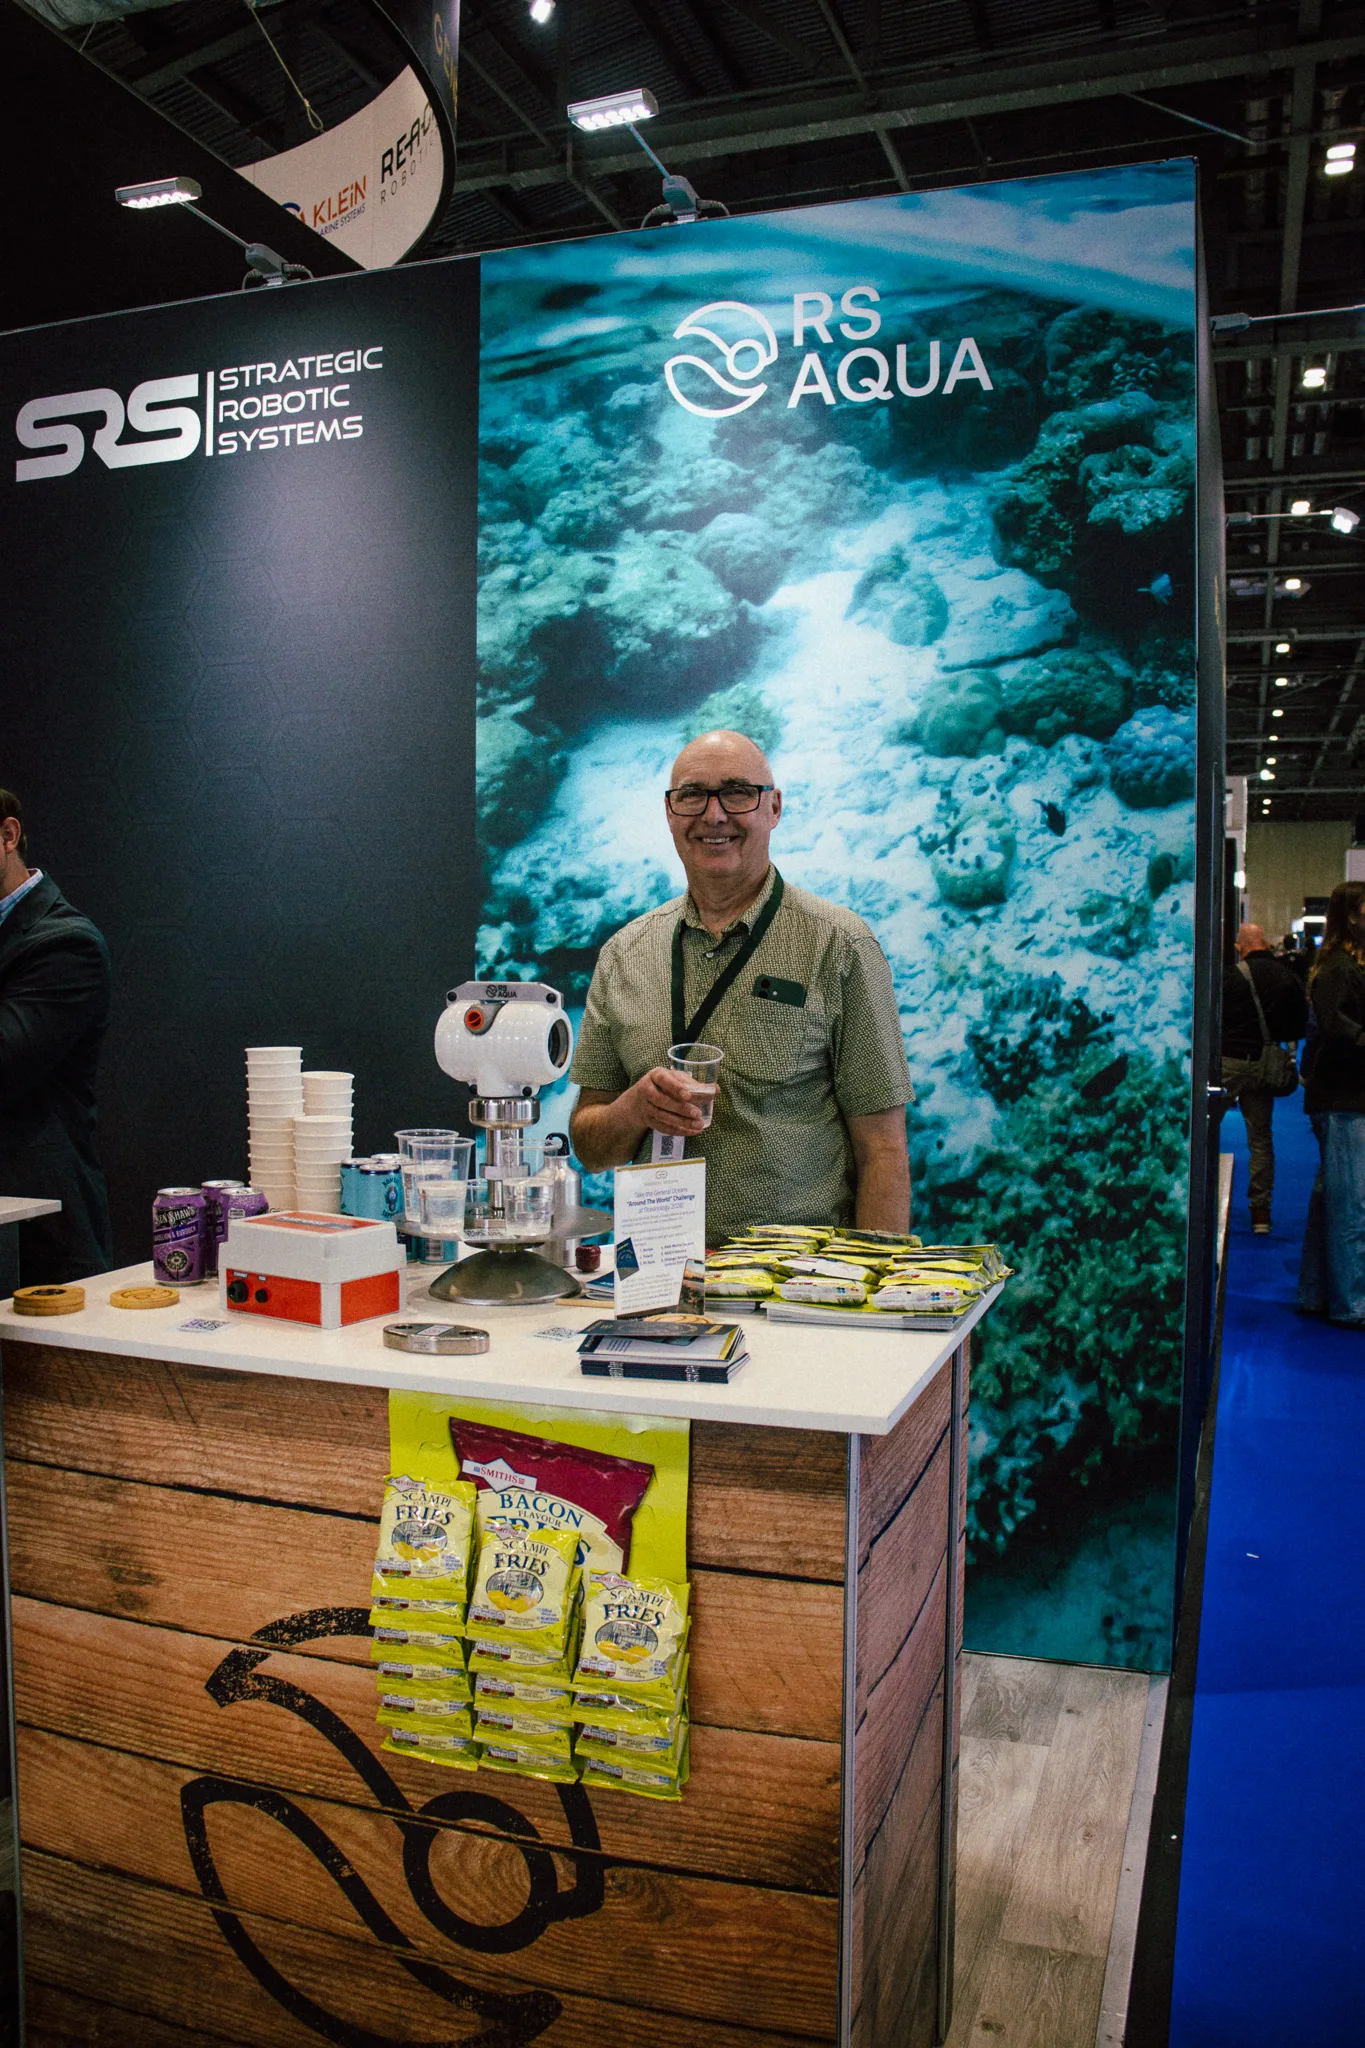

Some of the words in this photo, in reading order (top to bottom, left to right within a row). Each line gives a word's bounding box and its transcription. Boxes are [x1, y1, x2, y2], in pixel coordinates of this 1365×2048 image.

[318, 219, 340, 236] ARINE
[340, 203, 366, 227] SYSTEMS
[793, 285, 882, 347] RS
[219, 346, 384, 391] STRATEGIC
[786, 337, 994, 409] AQUA
[219, 384, 350, 423] ROBOTIC
[15, 373, 202, 483] SRS
[218, 415, 364, 455] SYSTEMS
[497, 990, 518, 999] AQUA
[653, 1188, 671, 1197] General
[671, 1187, 688, 1195] Oceans
[480, 1466, 519, 1484] SMITHS
[401, 1492, 452, 1507] SCAMPI
[499, 1493, 584, 1528] BACON
[395, 1504, 455, 1526] FRIES
[518, 1510, 562, 1528] FLAVOUR
[502, 1540, 549, 1557] SCAMPI
[494, 1553, 551, 1577] FRIES
[610, 1589, 664, 1607] SCAMPI
[603, 1603, 665, 1627] FRIES
